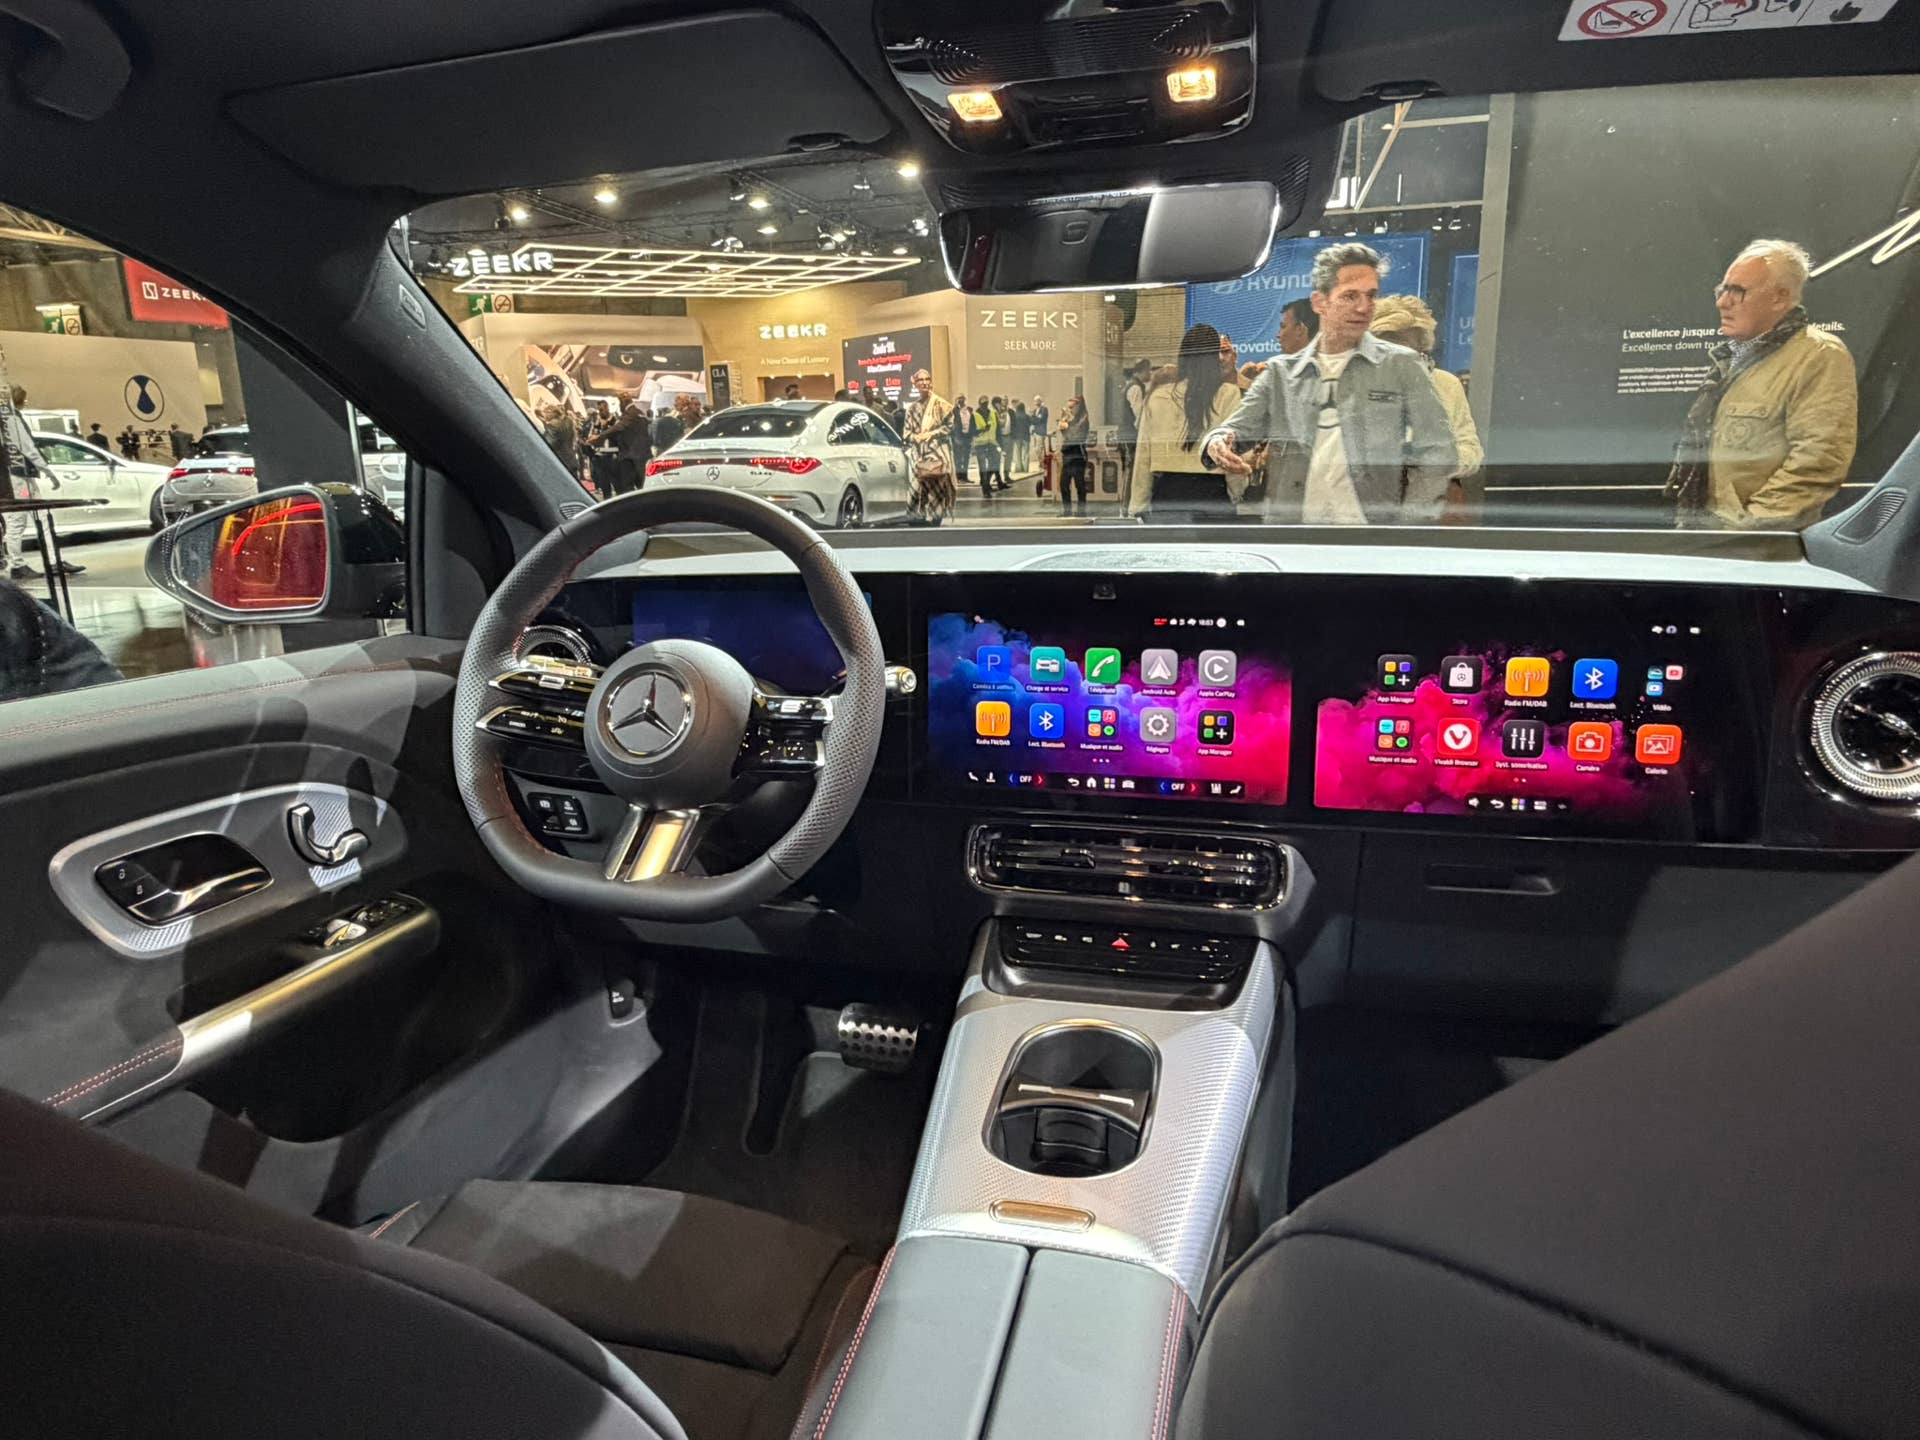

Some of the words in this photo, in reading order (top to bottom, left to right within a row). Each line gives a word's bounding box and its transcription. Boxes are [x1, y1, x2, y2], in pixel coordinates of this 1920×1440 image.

[450, 251, 553, 276] ZEEKR
[1247, 274, 1313, 291] HYUND
[161, 287, 206, 300] ZEEK
[981, 310, 1078, 328] ZEEKR
[759, 323, 828, 339] ZEEKR
[1623, 328, 1680, 339] L'excellence
[1682, 328, 1715, 338] jusque
[1004, 340, 1028, 350] SEEK
[1031, 340, 1057, 350] MORE
[1622, 342, 1672, 352] Excellence
[1675, 341, 1702, 350] down
[1705, 341, 1715, 349] to
[1142, 688, 1163, 696] Android
[1199, 690, 1214, 698] Apple
[1215, 691, 1236, 699] CarPlay
[1377, 695, 1390, 703] App
[1390, 696, 1415, 704] Manager
[1586, 702, 1617, 710] Bluetooth
[1198, 748, 1211, 756] App
[1211, 749, 1233, 757] Manager
[1019, 775, 1032, 783] OFF
[1171, 783, 1185, 791] OFF
